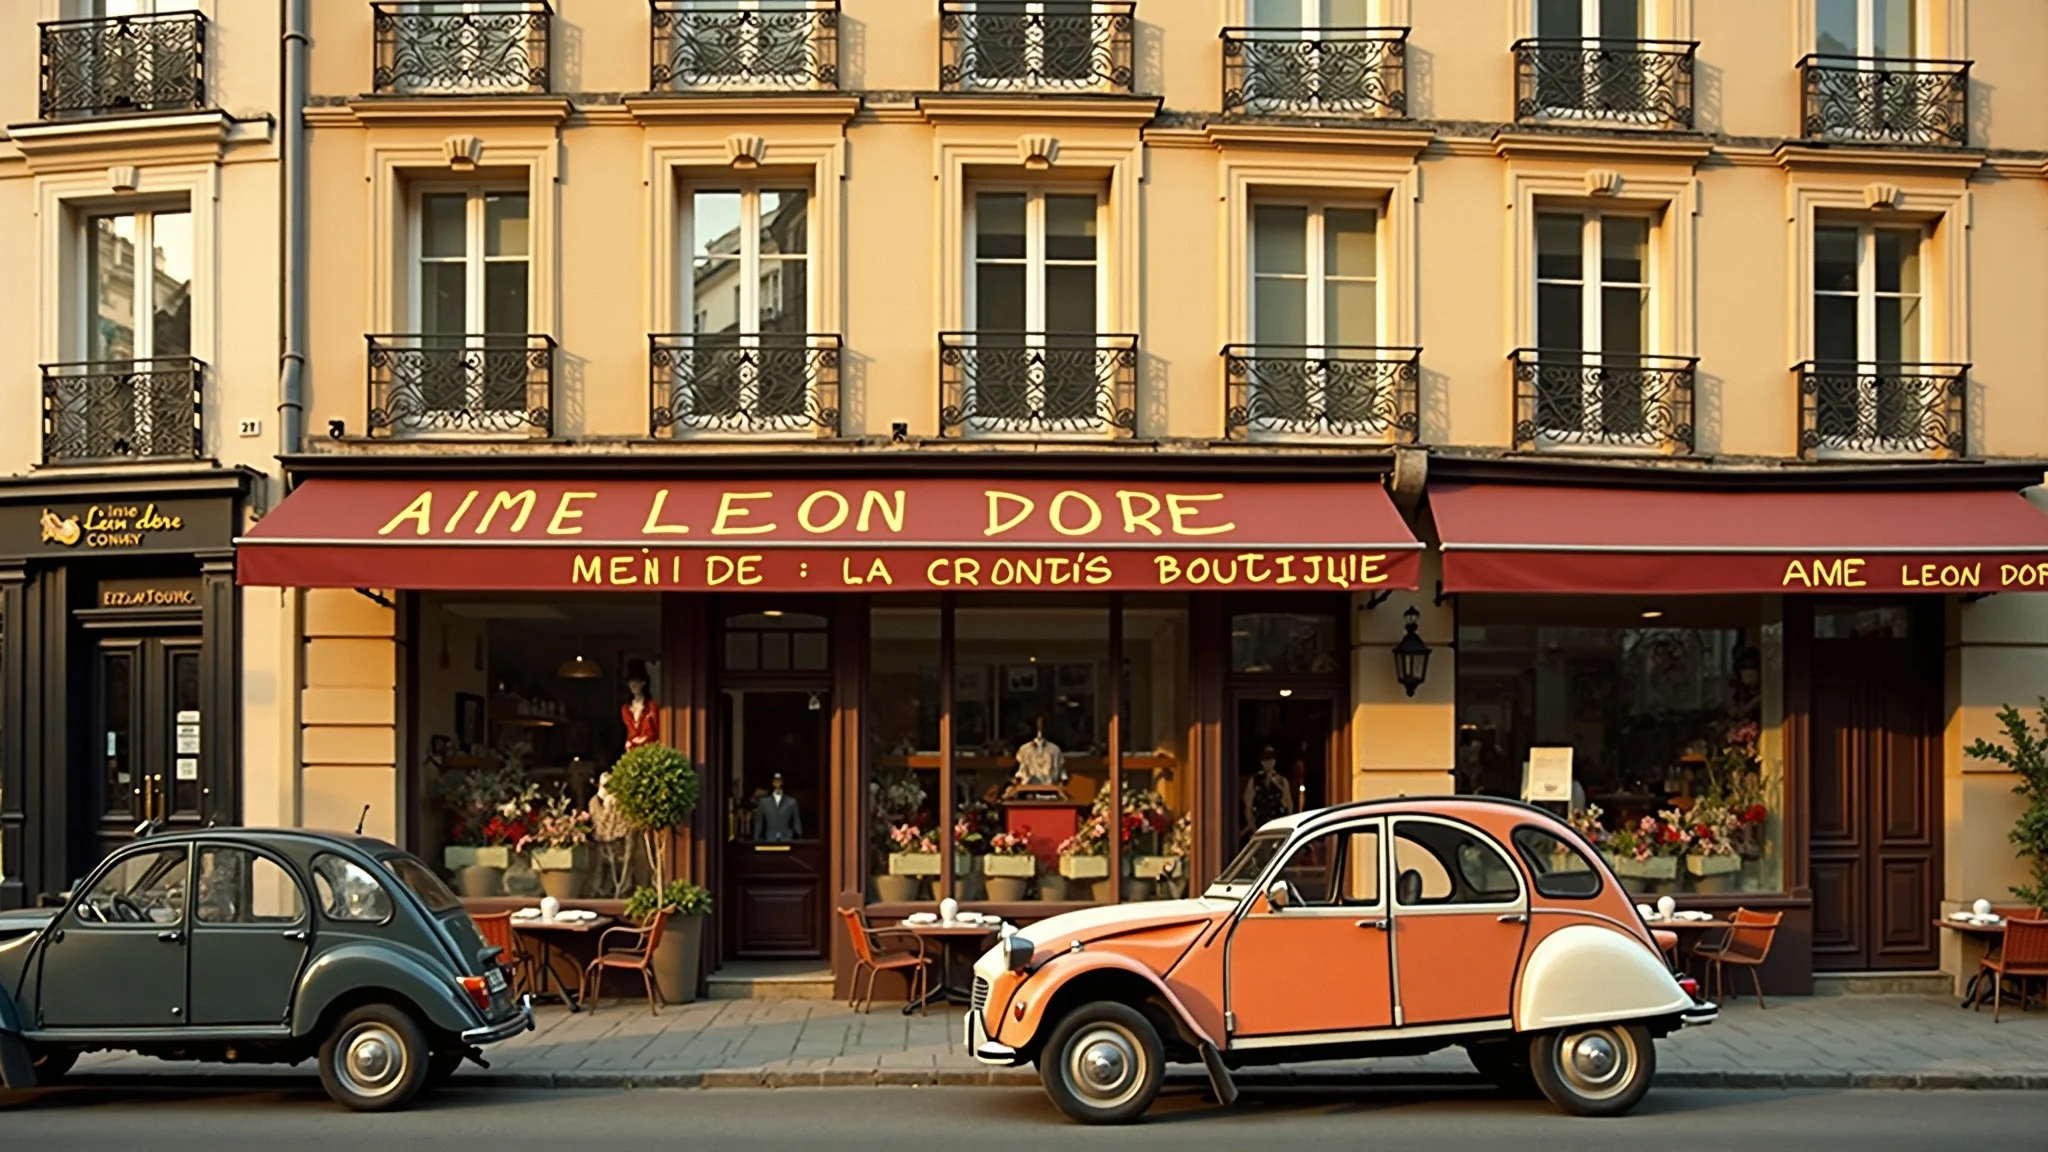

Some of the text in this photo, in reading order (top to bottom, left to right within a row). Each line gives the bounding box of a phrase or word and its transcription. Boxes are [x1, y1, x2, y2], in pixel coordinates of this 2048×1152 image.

[378, 489, 1236, 536] AIME LEON DORE
[705, 555, 763, 586] DE
[843, 557, 893, 586] LA
[1782, 558, 1867, 587] AME
[1902, 562, 1981, 587] LEON
